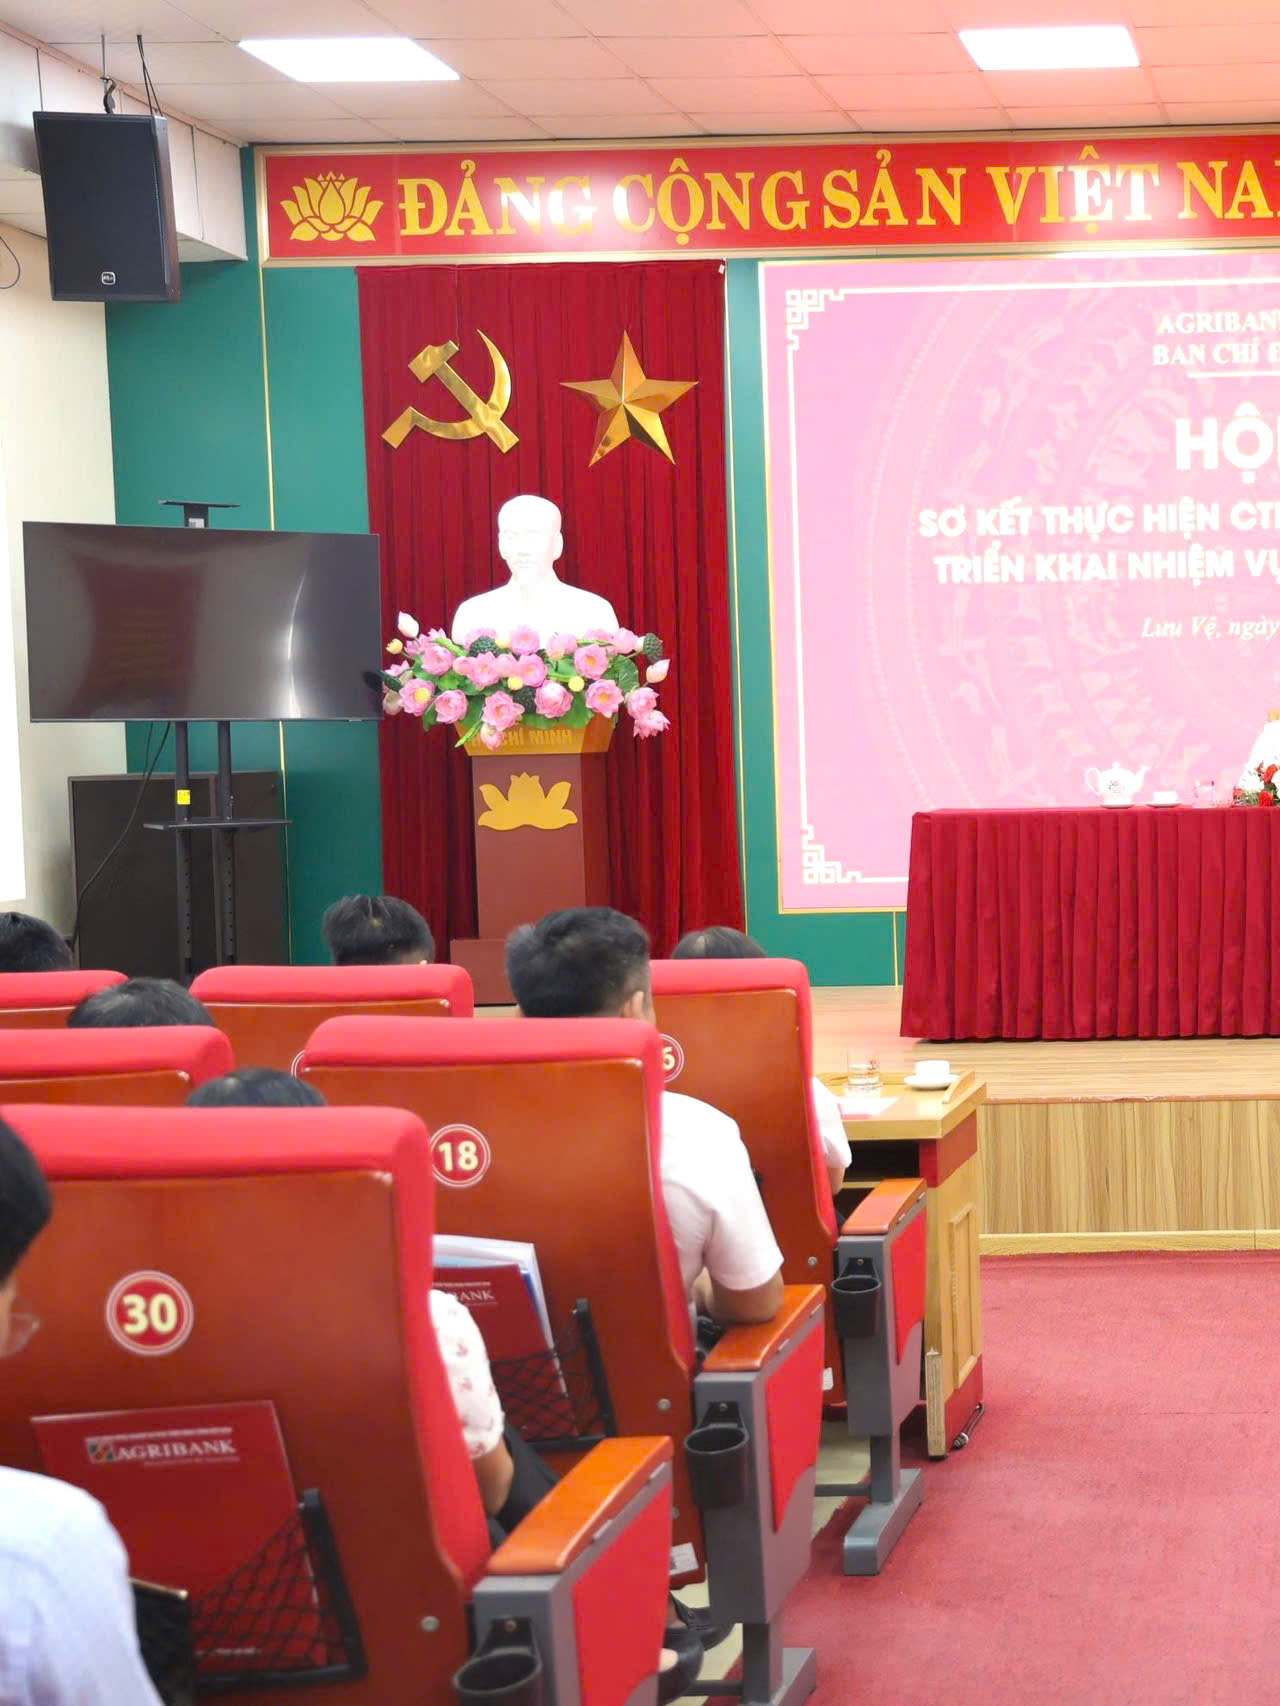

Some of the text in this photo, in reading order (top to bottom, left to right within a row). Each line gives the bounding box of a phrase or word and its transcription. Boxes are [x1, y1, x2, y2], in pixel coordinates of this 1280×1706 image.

[398, 159, 598, 236] ĐẢNG
[612, 157, 810, 246] CỘNG
[822, 149, 963, 229] SẢN
[986, 145, 1160, 234] VIỆT
[1152, 344, 1207, 366] BAN
[919, 504, 967, 536] SƠ
[976, 497, 1032, 535] KẾT
[1042, 500, 1135, 541] THỰC
[1143, 497, 1220, 539] HIỆN
[933, 540, 1025, 583] TRIỂN
[1035, 554, 1117, 582] KHAI
[1128, 544, 1235, 586] NHIỆM
[1228, 617, 1280, 640] ngày
[438, 1141, 479, 1171] 18
[123, 1294, 178, 1334] 30
[118, 1440, 235, 1460] AGRIBANK
